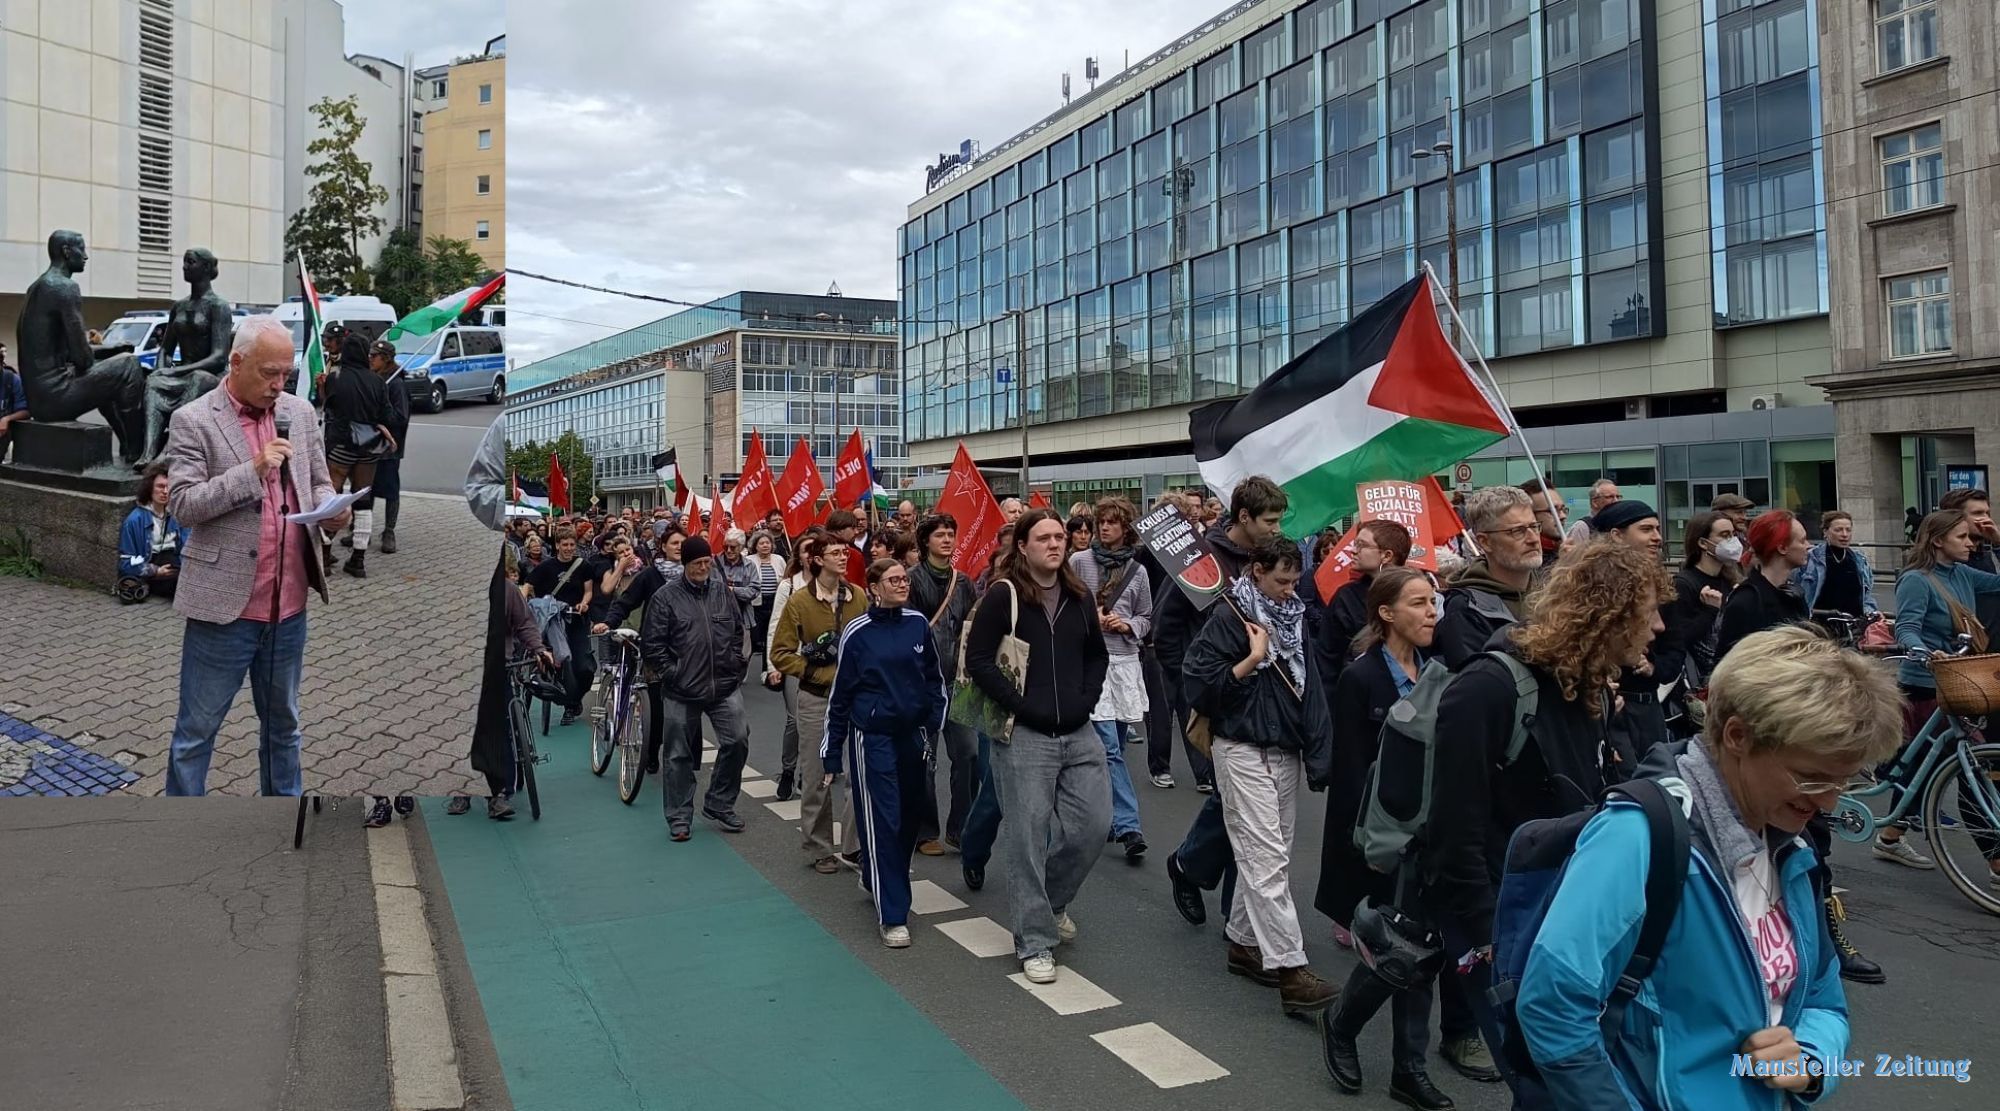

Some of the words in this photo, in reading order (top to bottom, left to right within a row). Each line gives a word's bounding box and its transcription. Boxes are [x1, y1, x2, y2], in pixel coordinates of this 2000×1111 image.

[713, 339, 731, 357] POST
[1364, 486, 1396, 500] GELD
[1399, 485, 1421, 501] FÜR
[1366, 499, 1423, 514] SOZIALES
[1136, 507, 1169, 534] SCHLUSS
[1150, 520, 1193, 552] BESATZUNGS
[1164, 533, 1196, 557] TERROR!
[1183, 549, 1202, 566] فلسطين
